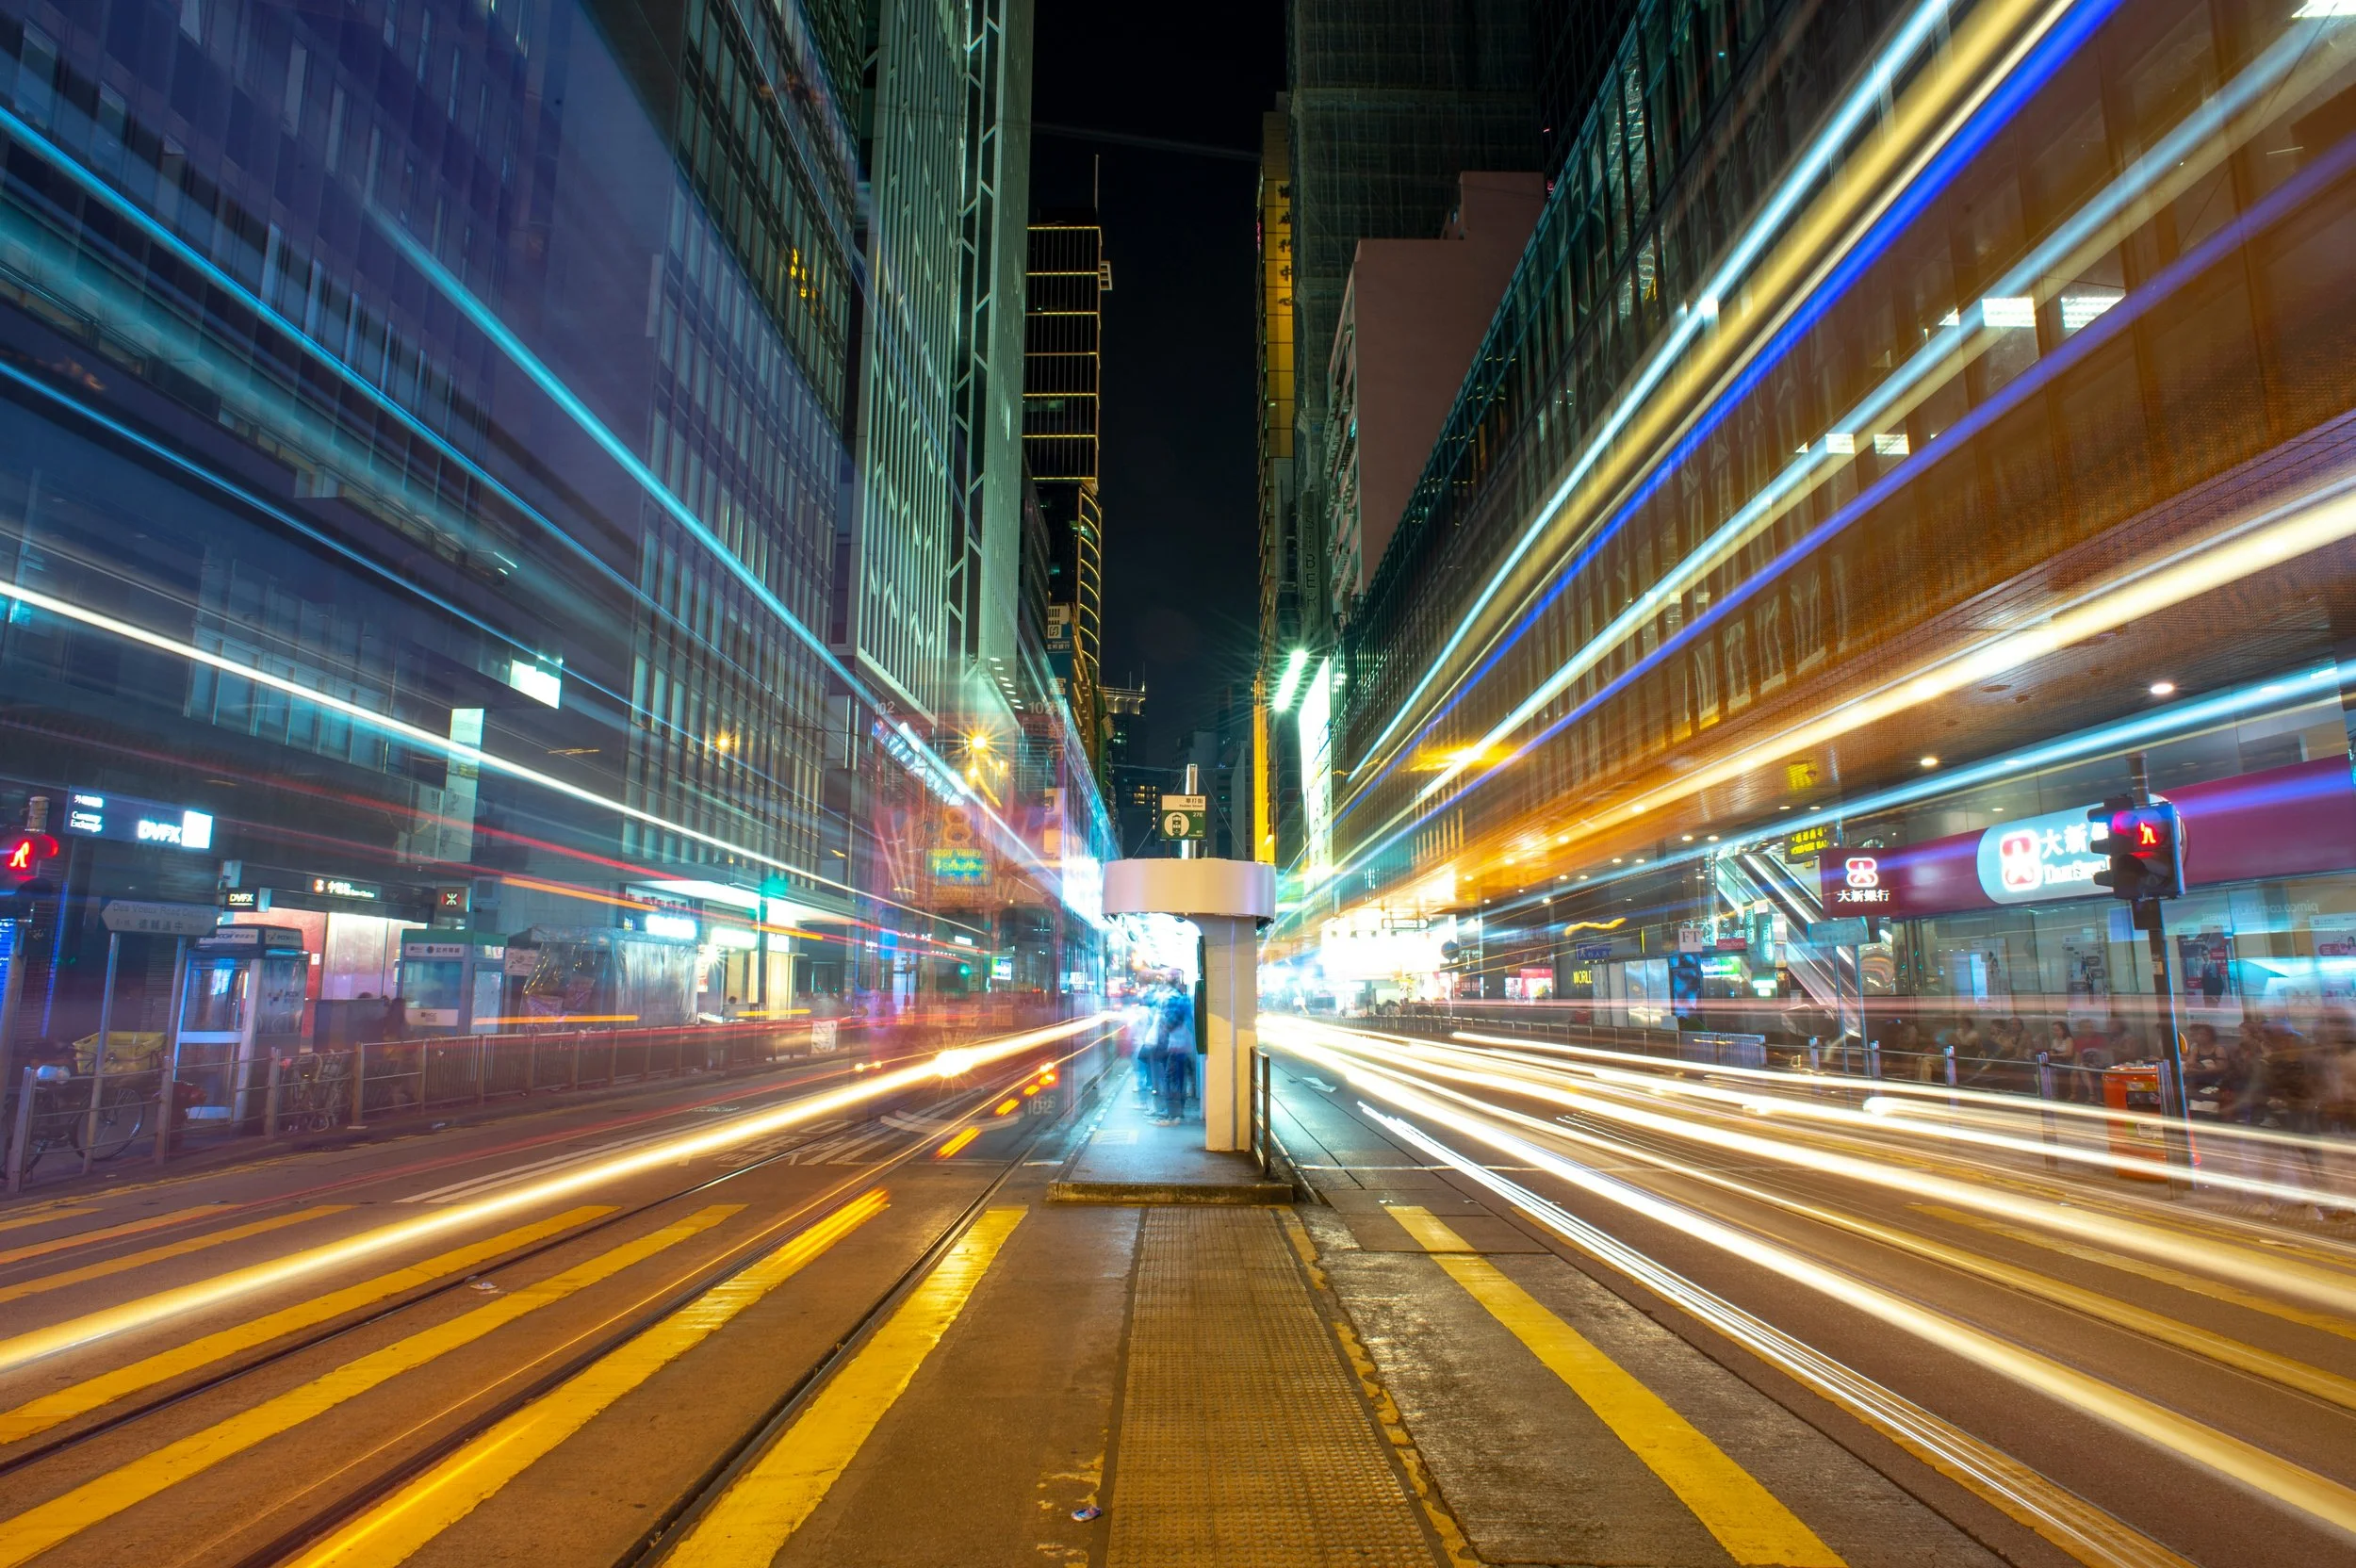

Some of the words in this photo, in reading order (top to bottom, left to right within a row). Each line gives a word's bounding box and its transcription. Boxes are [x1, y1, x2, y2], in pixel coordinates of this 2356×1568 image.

[138, 820, 182, 843] DVFX
[956, 849, 981, 858] Valley
[228, 893, 254, 903] DVFX
[1837, 890, 1890, 903] 大新銀行
[113, 903, 130, 912] Des
[132, 905, 157, 914] Voeux
[160, 906, 181, 916] Road
